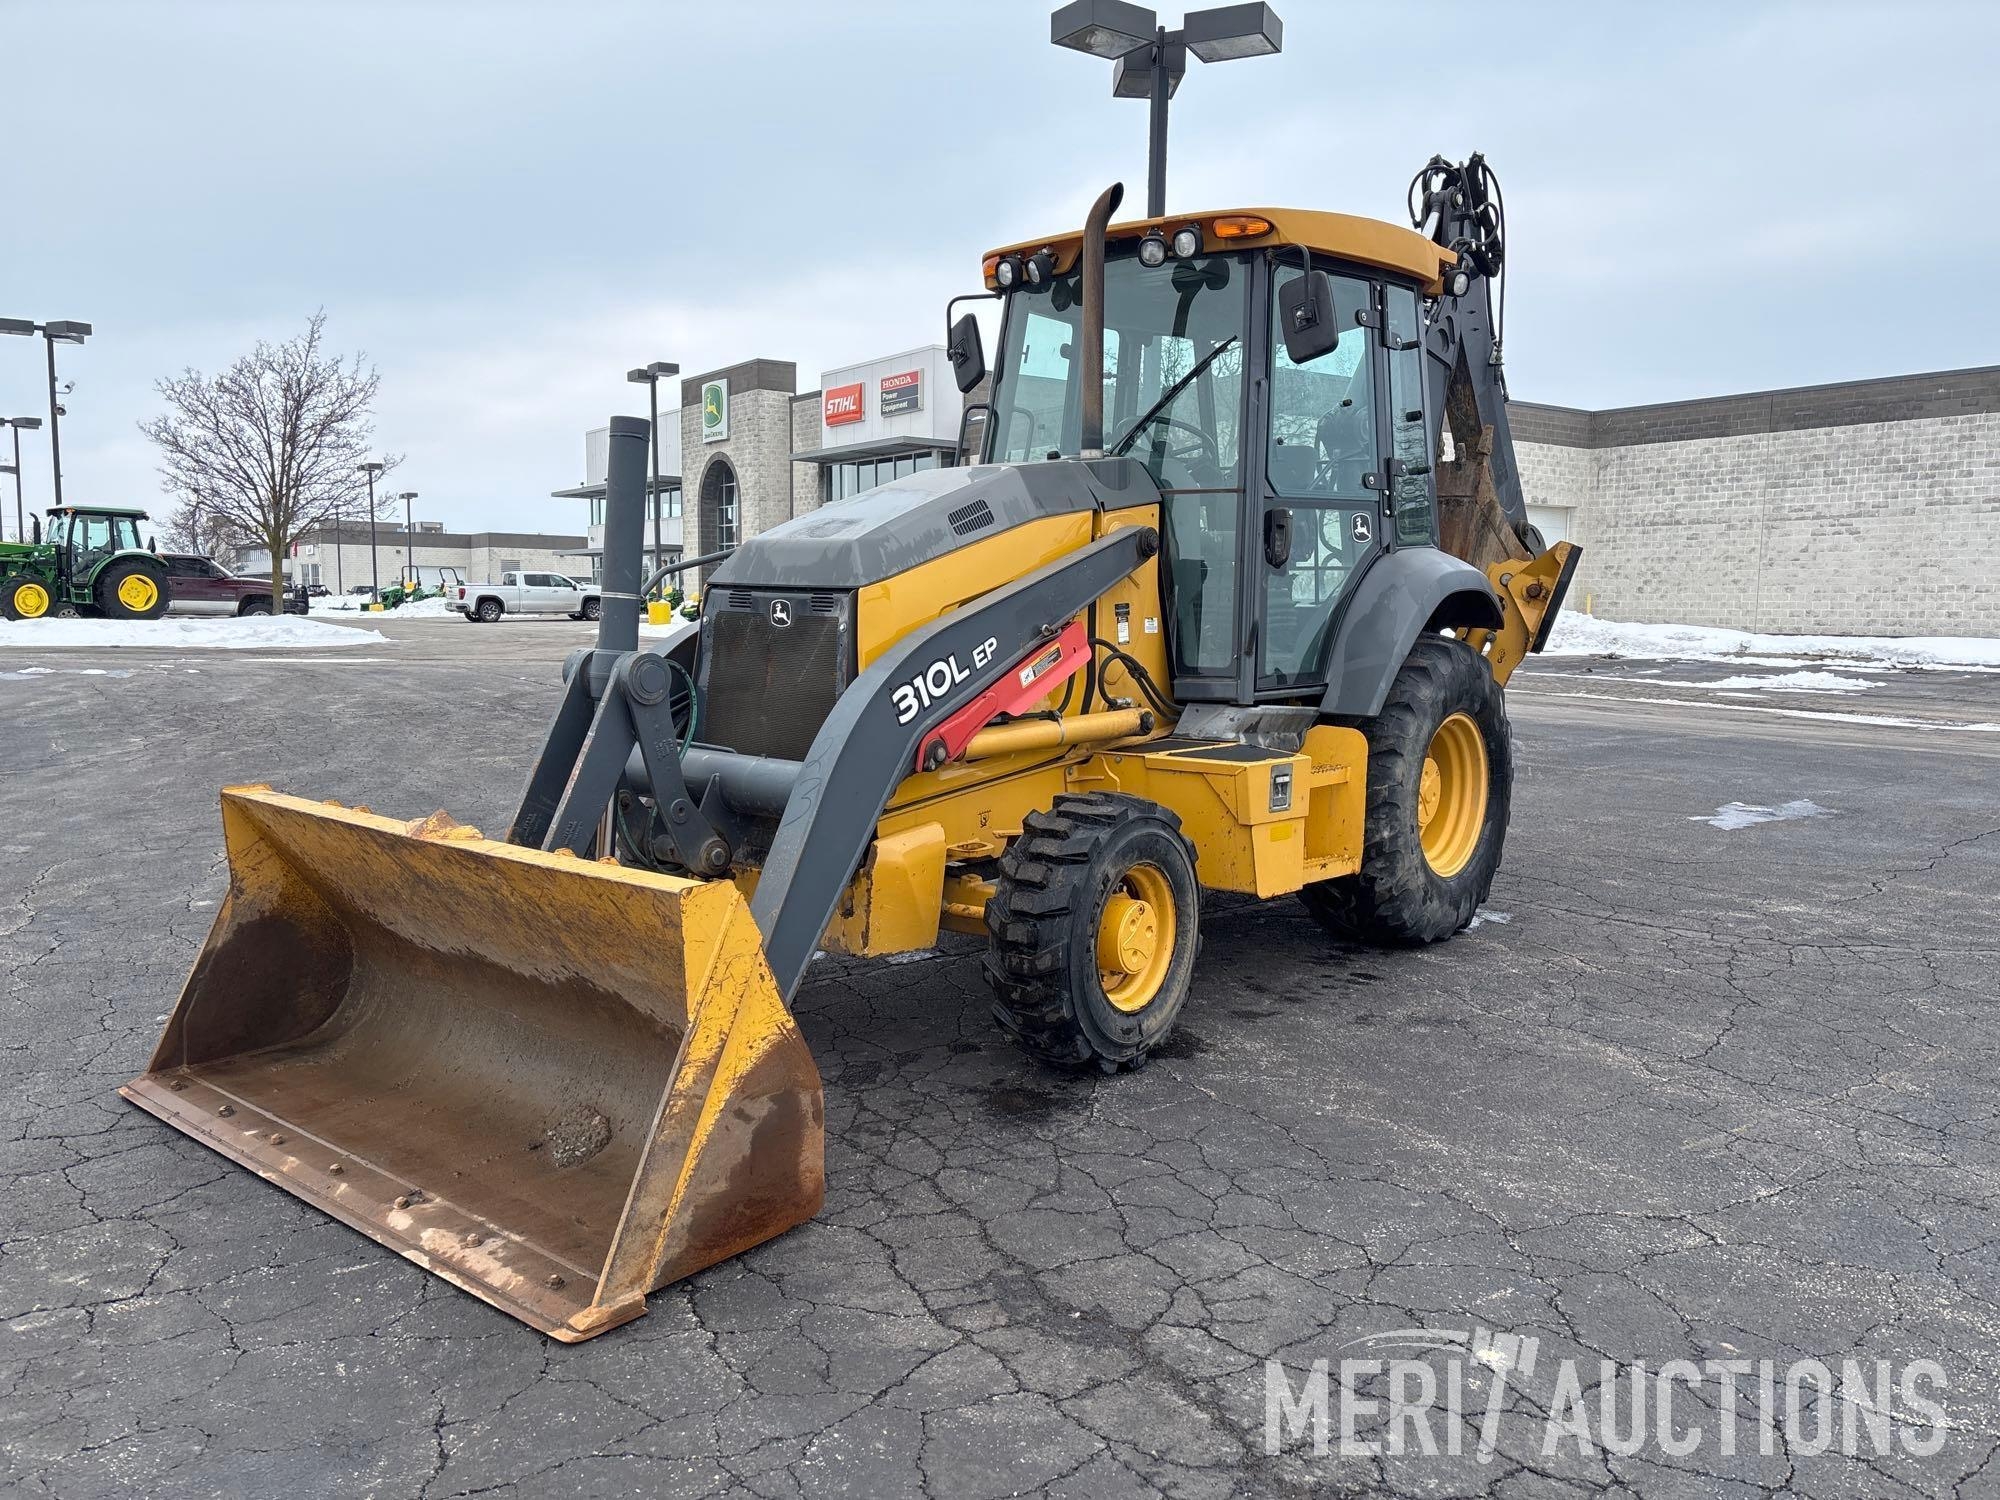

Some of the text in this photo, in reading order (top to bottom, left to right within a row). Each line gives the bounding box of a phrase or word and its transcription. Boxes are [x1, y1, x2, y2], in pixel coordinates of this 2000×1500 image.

[882, 375, 911, 389] HONDA
[882, 392, 898, 401] Power
[826, 394, 857, 415] STIHL
[882, 400, 908, 412] Equipment
[891, 654, 971, 725] 310L
[972, 636, 998, 670] EP
